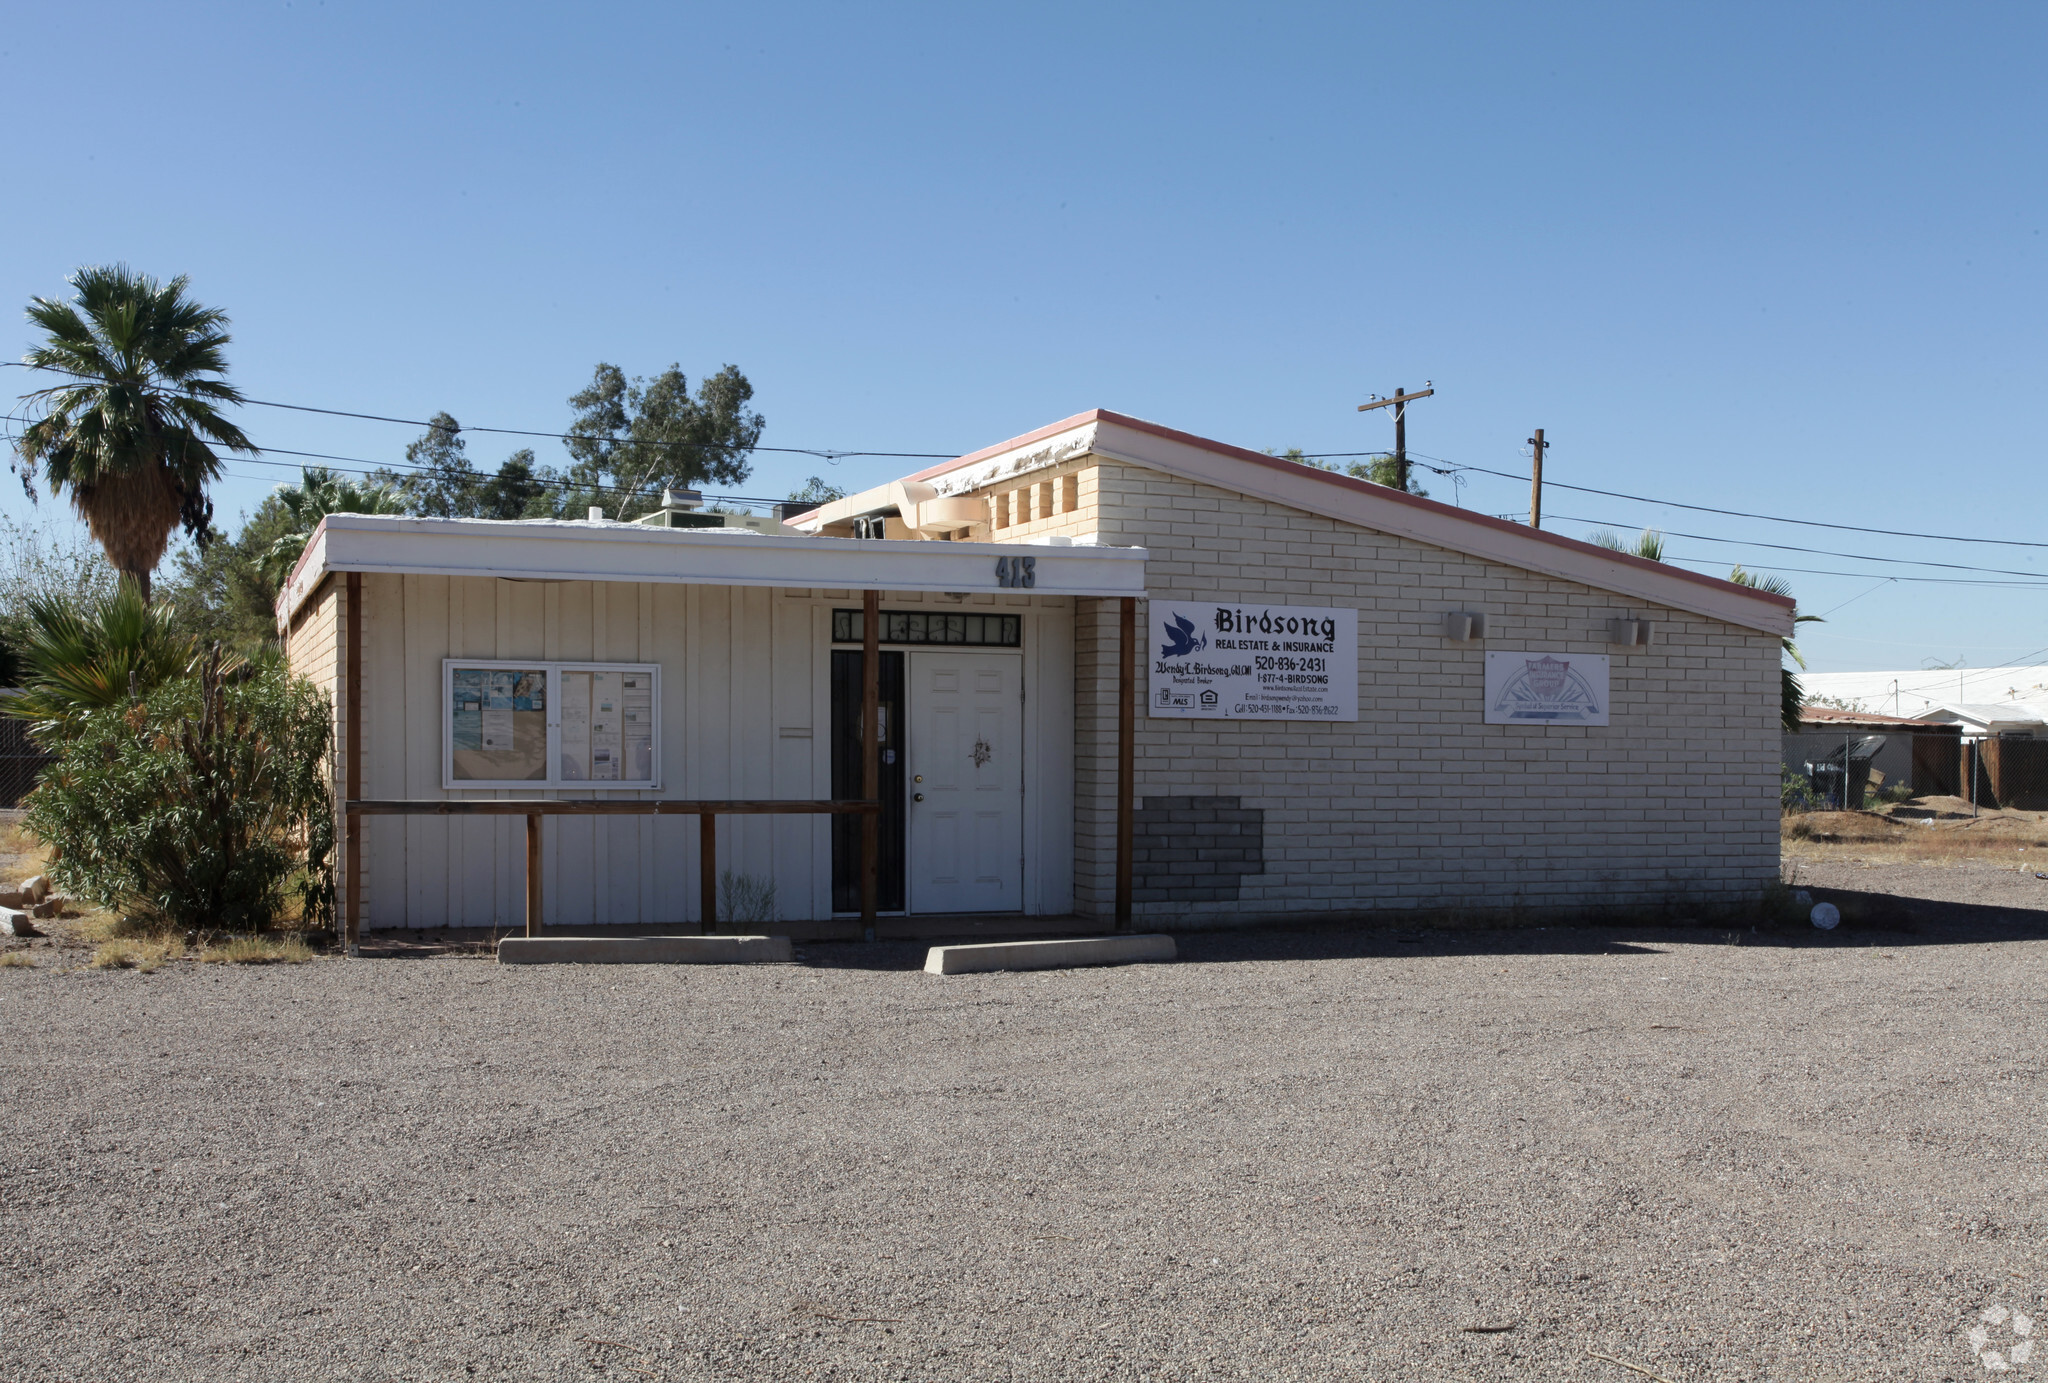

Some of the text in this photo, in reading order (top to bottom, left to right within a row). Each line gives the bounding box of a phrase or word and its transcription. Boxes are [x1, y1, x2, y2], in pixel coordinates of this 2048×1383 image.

[995, 555, 1036, 588] 413
[1214, 607, 1336, 642] Birdsong
[1215, 639, 1335, 653] REAL ESTATE & INSURANCE
[1155, 661, 1185, 676] Wendy
[1255, 656, 1326, 672] 520-836-2431
[1528, 662, 1564, 671] FARMERS
[1196, 676, 1213, 684] Broker
[1257, 673, 1329, 684] 1-877-4-BIRDSONG
